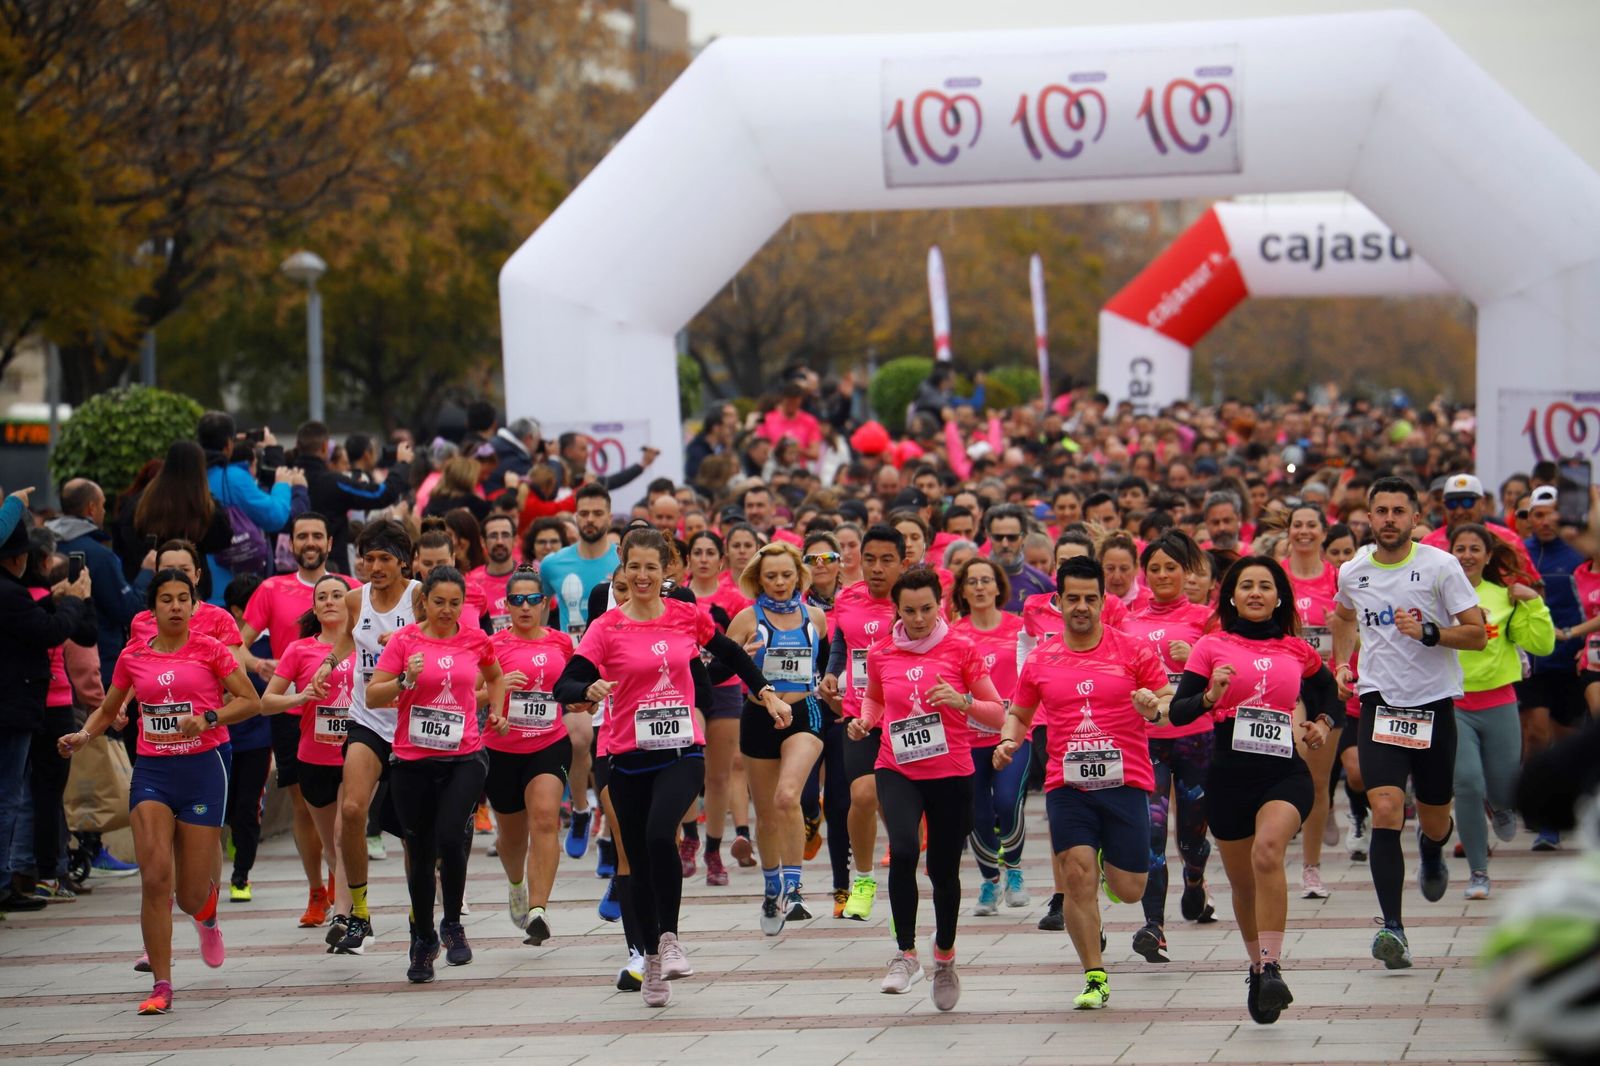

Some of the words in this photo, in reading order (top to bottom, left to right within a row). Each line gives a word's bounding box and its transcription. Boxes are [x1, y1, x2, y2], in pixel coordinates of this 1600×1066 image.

[781, 659, 799, 671] 191
[523, 703, 547, 716] 1119
[150, 716, 178, 731] 1704
[421, 720, 450, 736] 1054
[648, 720, 680, 736] 1020
[1389, 719, 1418, 736] 1798
[901, 728, 931, 748] 1419
[1249, 722, 1282, 741] 1032
[1067, 739, 1114, 752] PINK
[1080, 763, 1106, 778] 640
